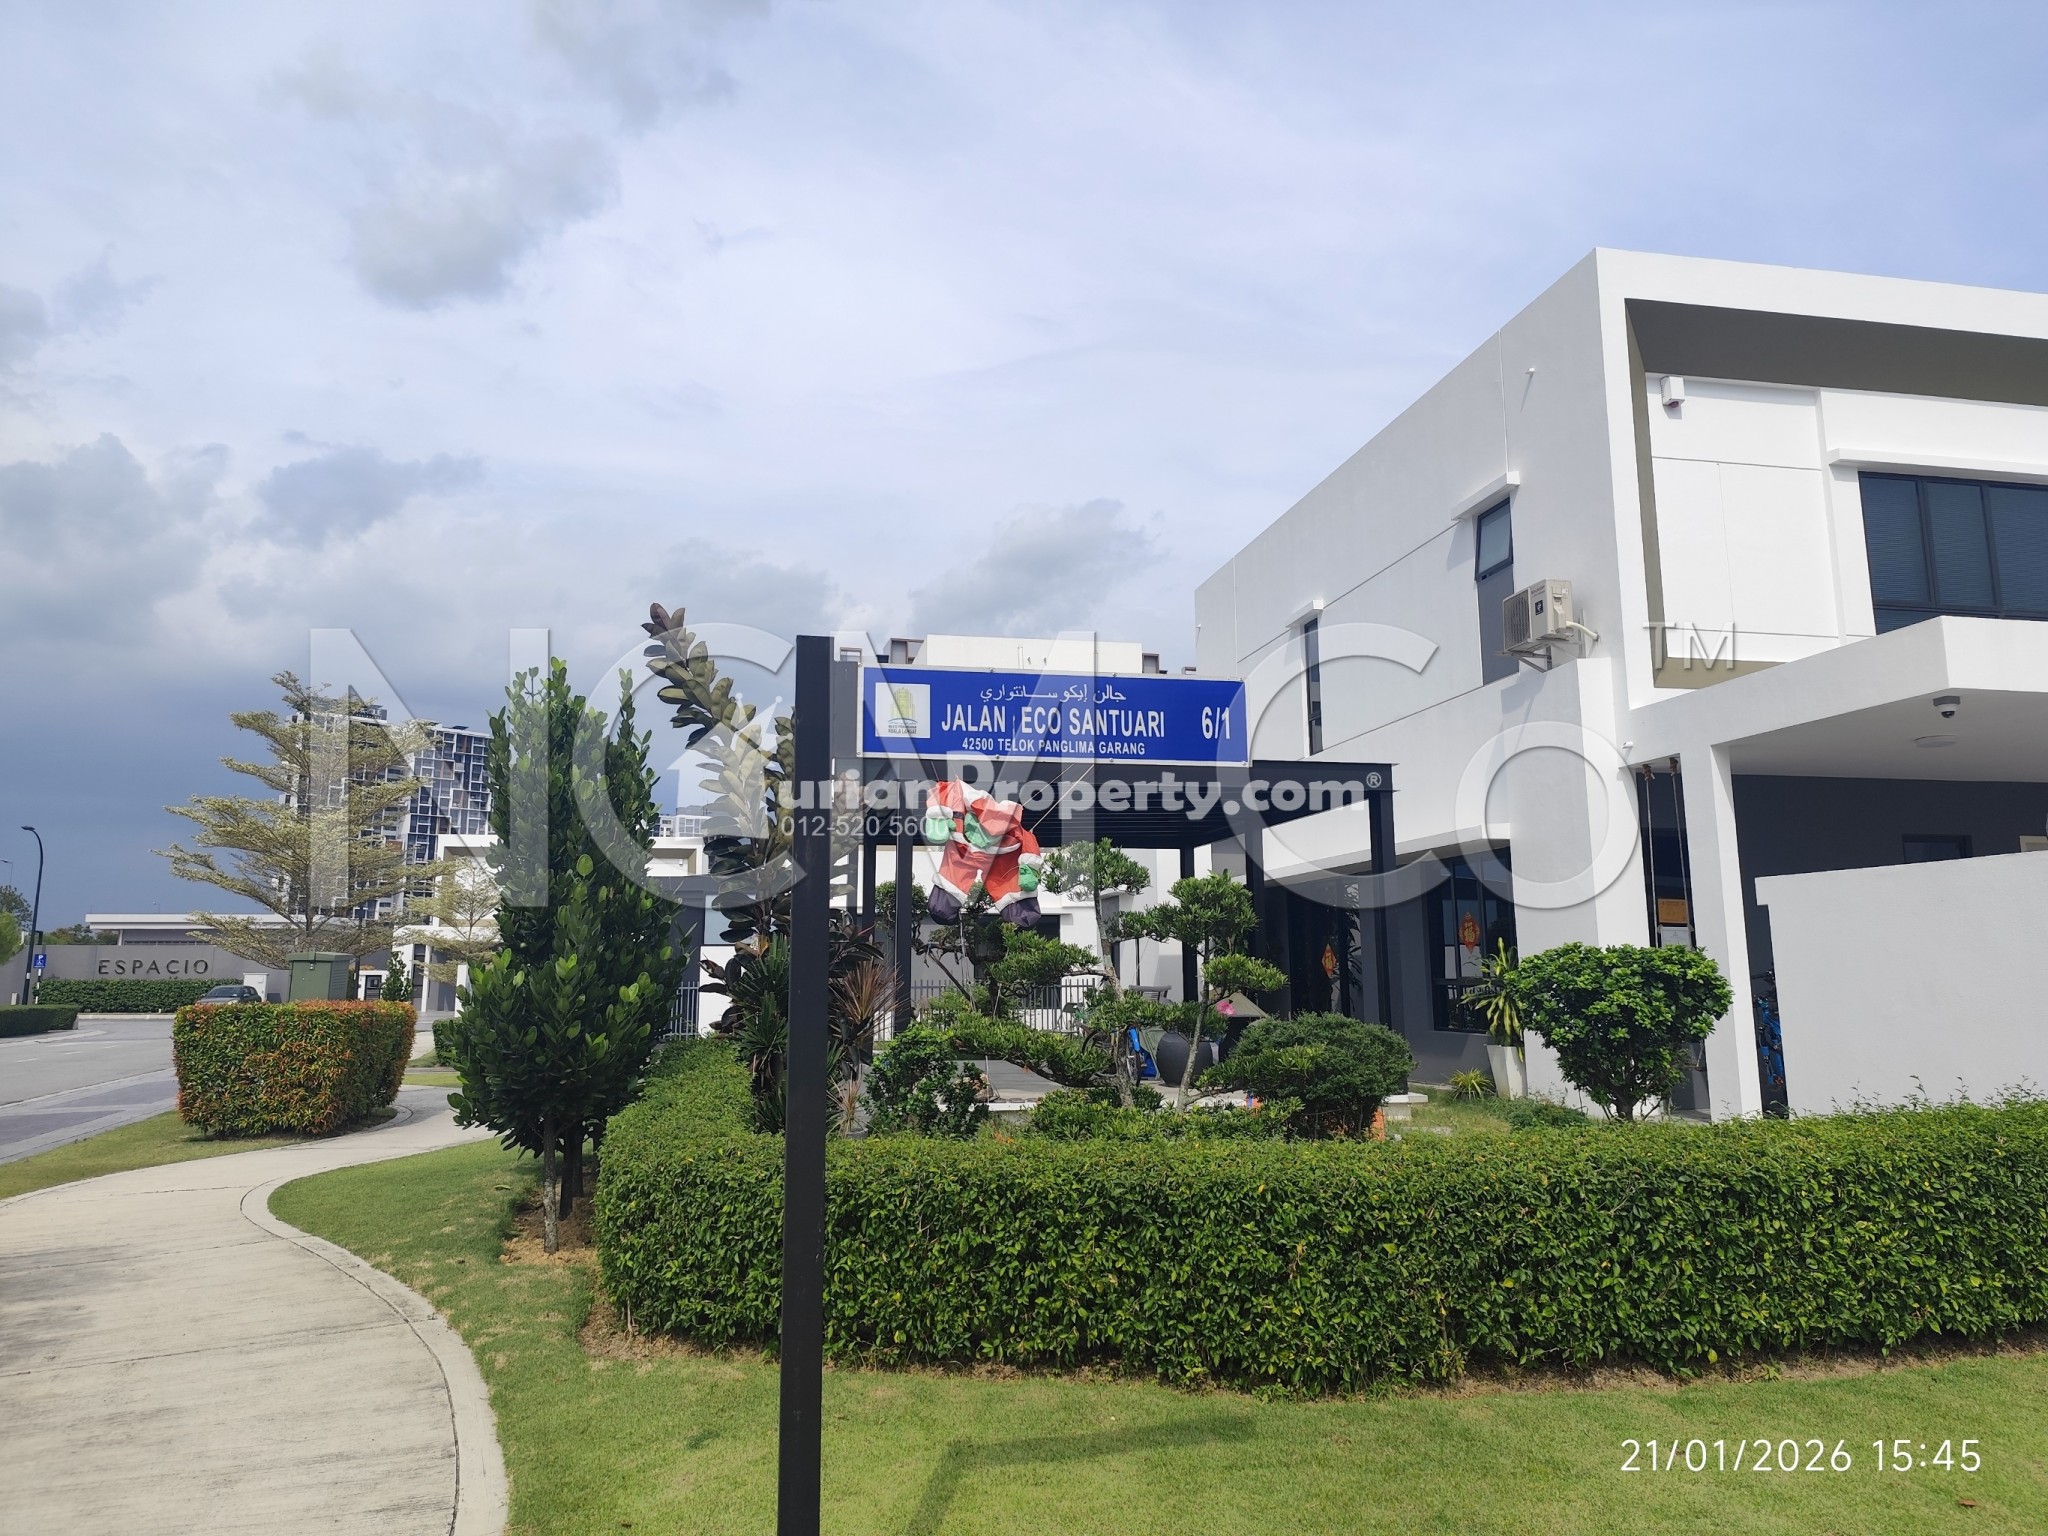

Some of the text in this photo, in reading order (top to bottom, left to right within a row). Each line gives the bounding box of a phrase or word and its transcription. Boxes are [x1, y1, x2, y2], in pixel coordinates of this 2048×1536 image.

[1092, 684, 1127, 704] جالن
[941, 703, 1231, 740] JALAN ECO SANTUARI 6/1
[962, 737, 1146, 756] 42500 TELOK PANGLIMA GARANG
[98, 959, 209, 975] ESPACIO
